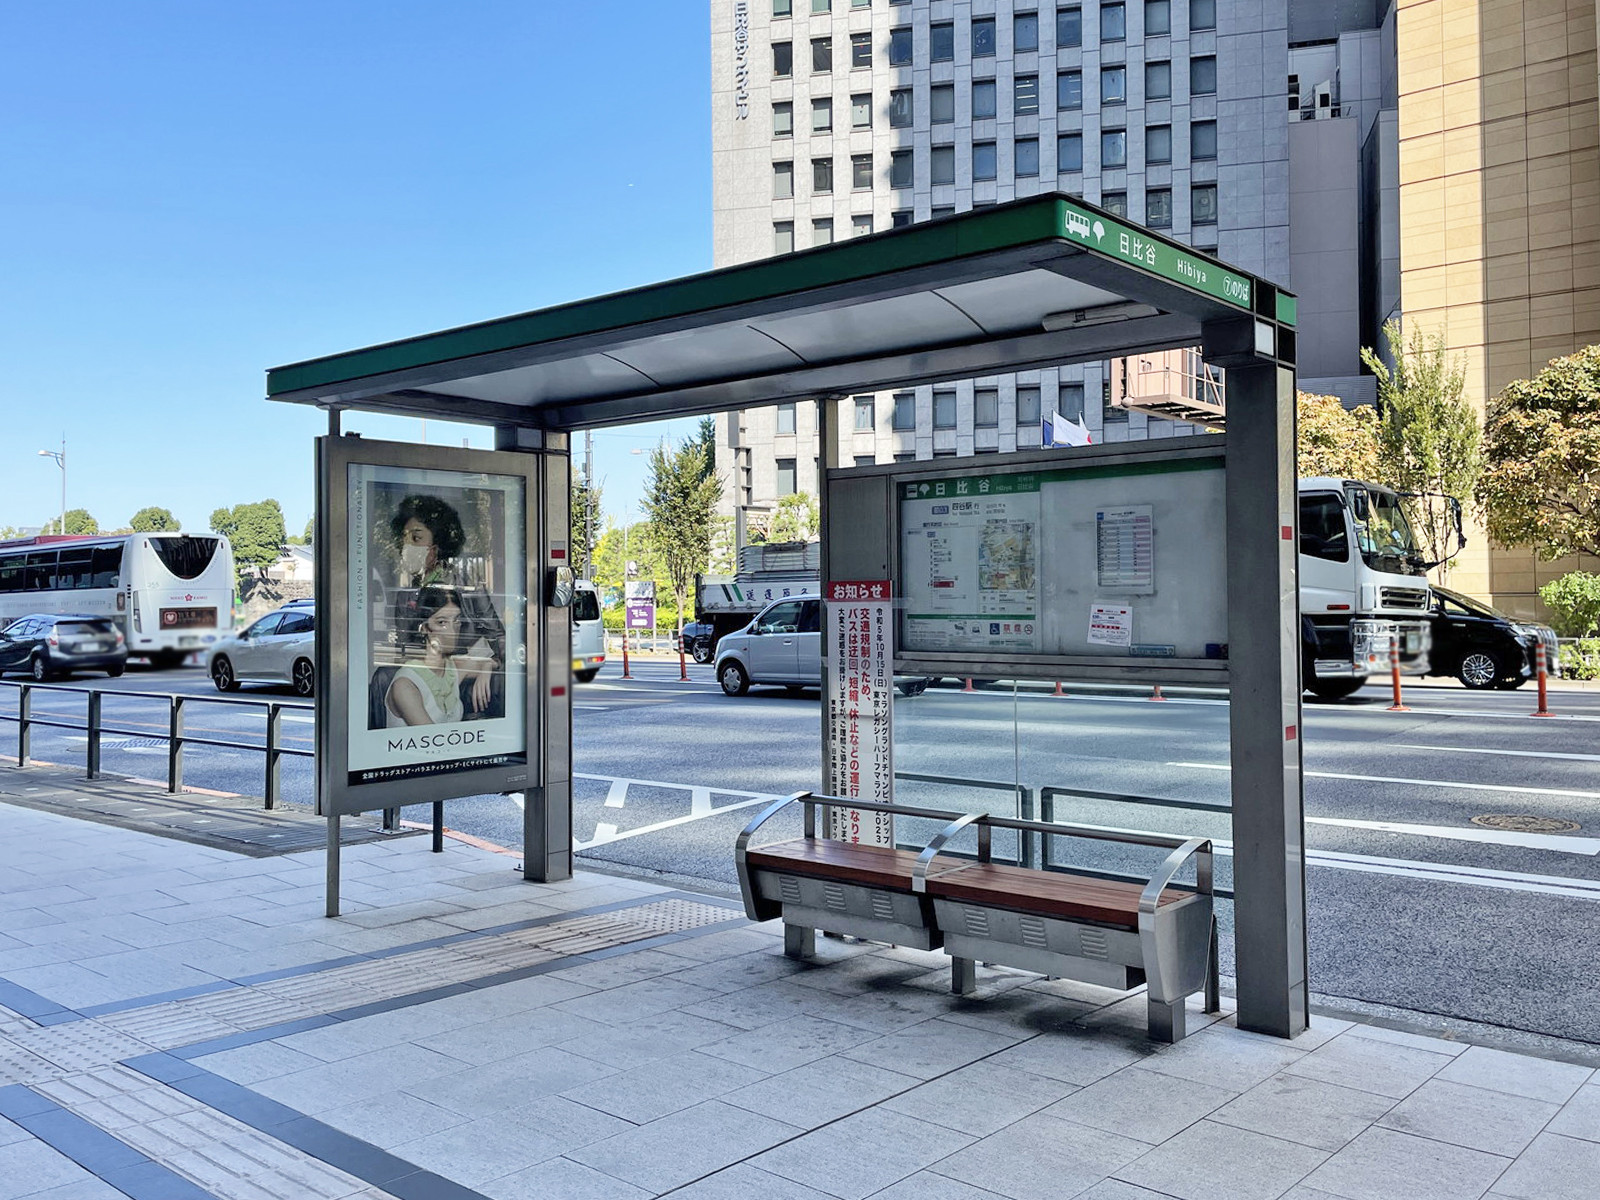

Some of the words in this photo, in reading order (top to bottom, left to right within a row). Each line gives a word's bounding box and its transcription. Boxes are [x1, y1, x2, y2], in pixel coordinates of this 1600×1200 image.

[1120, 233, 1156, 266] 日比谷
[1177, 258, 1207, 284] Hibiya
[935, 479, 990, 496] 日比谷
[356, 567, 364, 610] FASHION
[833, 584, 883, 599] お知らせ
[860, 608, 871, 701] 交通規制のため、
[848, 608, 860, 846] バスは迂回、短縮、休止などの運行なりま
